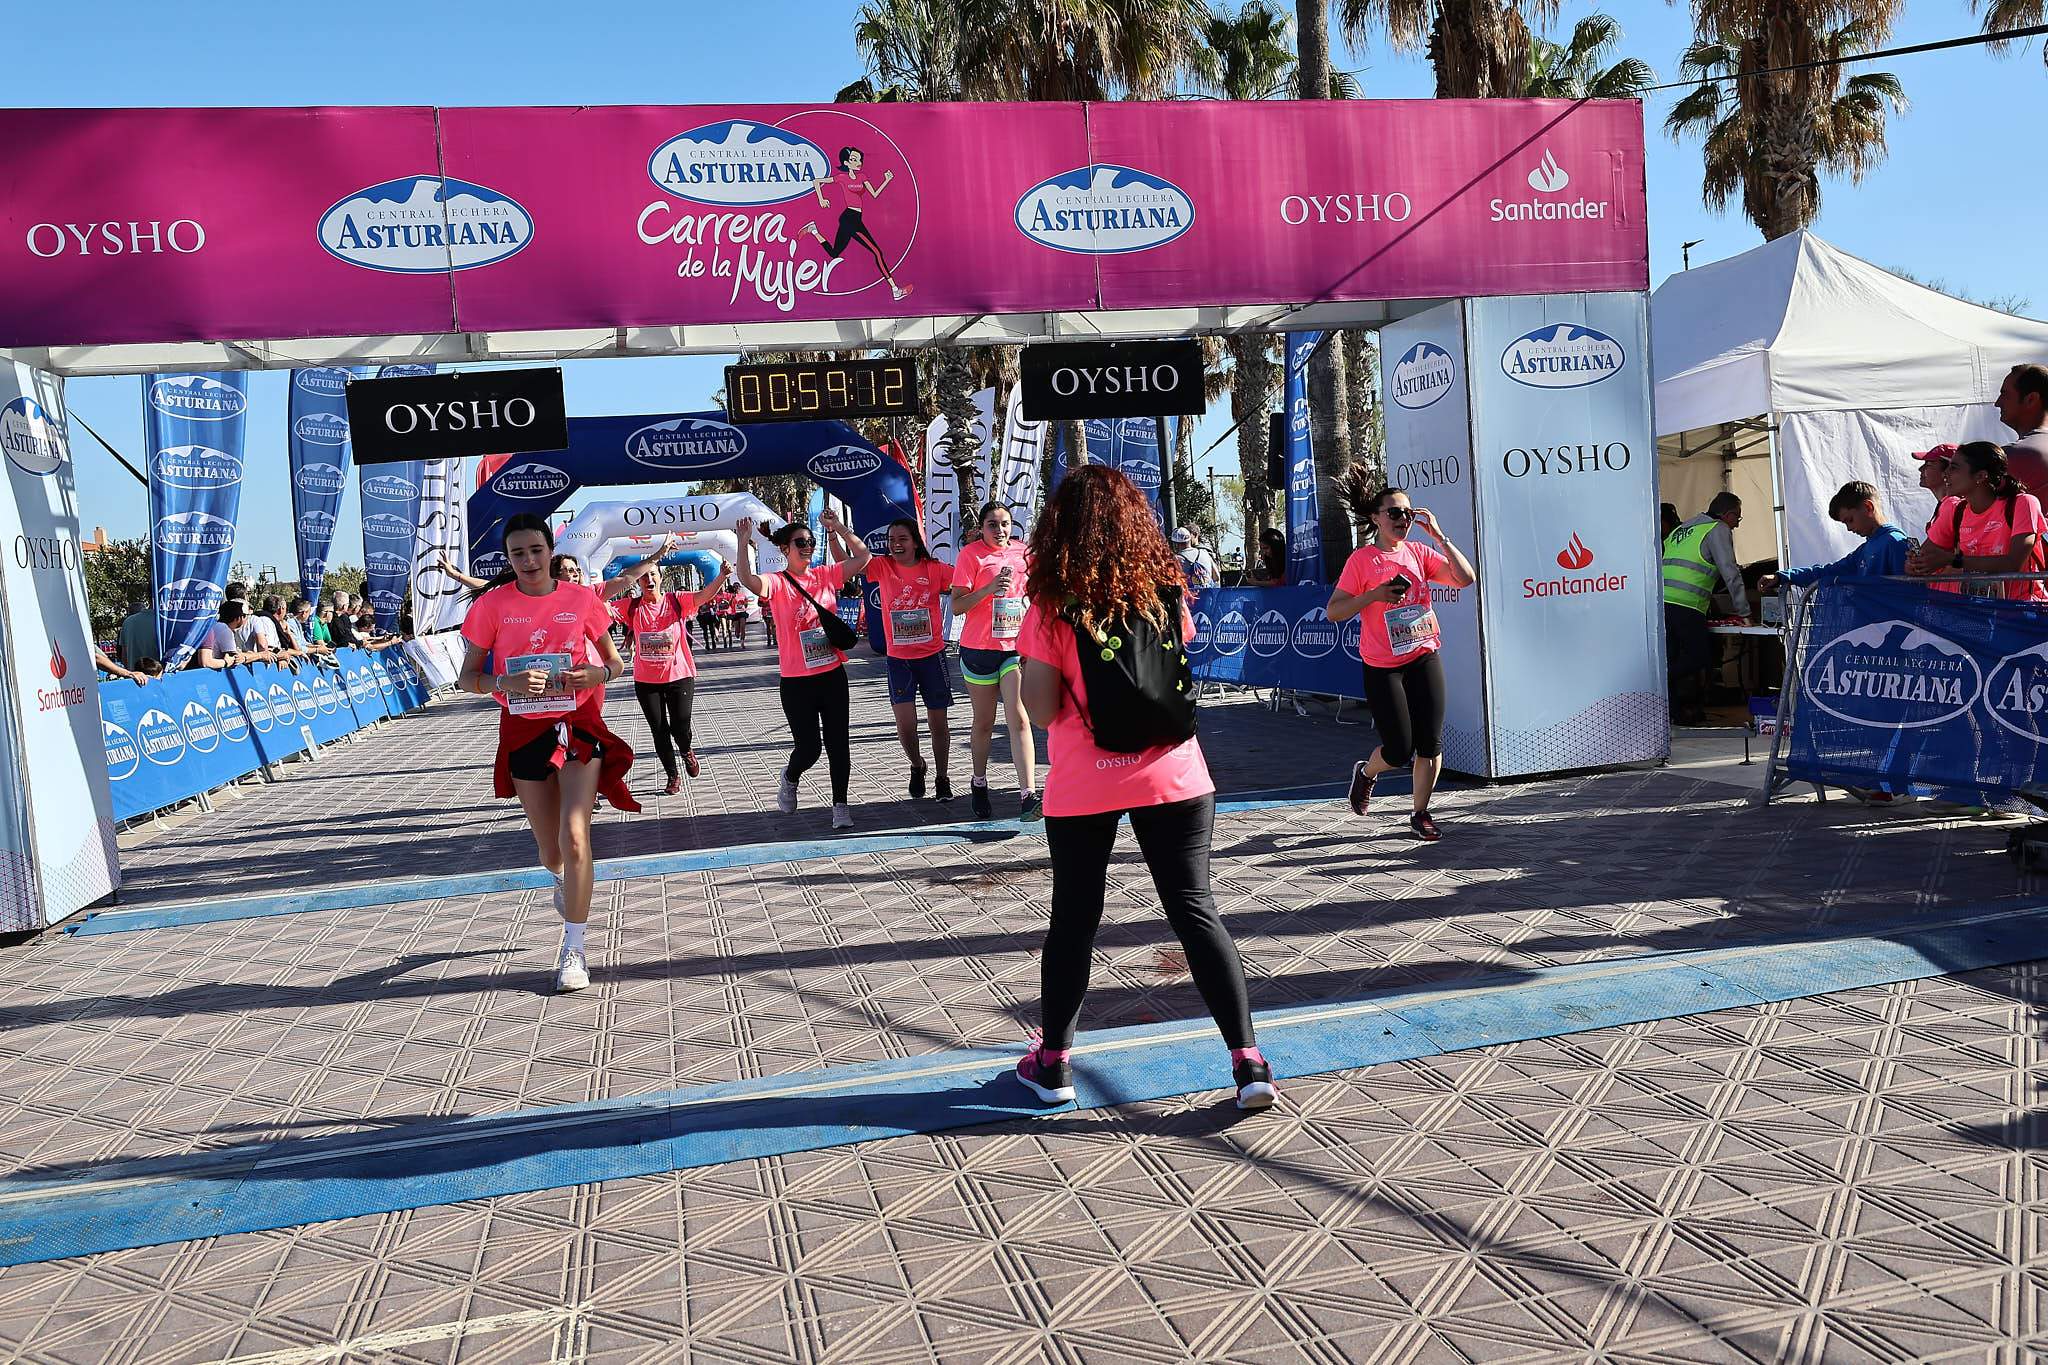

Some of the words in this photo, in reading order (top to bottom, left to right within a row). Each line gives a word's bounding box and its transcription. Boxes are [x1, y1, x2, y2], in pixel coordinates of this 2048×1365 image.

[689, 150, 747, 159] CENTRAL
[753, 149, 810, 158] LECHERA
[663, 151, 816, 184] ASTURIANA
[1056, 195, 1113, 205] CENTRAL
[1117, 194, 1176, 203] LECHERA
[1279, 192, 1412, 225] OYSHO
[1489, 197, 1608, 222] Santander
[367, 208, 434, 220] CENTRAL
[637, 200, 789, 245] Carrera
[1030, 199, 1182, 232] ASTURIANA
[26, 218, 206, 258] OYSHO
[336, 213, 519, 250] ASTURIANA
[677, 248, 706, 278] de
[712, 246, 732, 277] la
[729, 240, 845, 312] Mujer
[1528, 346, 1568, 354] CENTRAL
[1571, 344, 1611, 352] LECHERA
[1510, 349, 1617, 374] ASTURIANA
[300, 373, 345, 390] ASTURIA
[739, 368, 904, 413] 00:59:12
[1051, 364, 1179, 397] OYSHO
[1395, 371, 1451, 398] ASTURIANA
[154, 387, 240, 411] ASTURIANA
[384, 397, 536, 434] OYSHO
[635, 436, 739, 458] ASTURIANA
[157, 458, 238, 480] ASTURIANA
[814, 459, 877, 473] ASTURIANA
[1503, 442, 1631, 478] OYSHO
[497, 478, 564, 491] ASTURIANA
[1397, 455, 1460, 491] OYSHO
[365, 482, 415, 497] ASTURIANA
[623, 502, 720, 527] OYSHO
[158, 527, 232, 545] ASTURIANA
[363, 520, 411, 535] ASTURIANA
[566, 531, 597, 540] OYSHO
[14, 534, 76, 571] OYSHO
[368, 563, 407, 573] STURIANA
[1429, 585, 1461, 603] ander
[1522, 572, 1628, 600] Santander
[503, 616, 532, 625] OYSHO
[1215, 622, 1246, 644] ASTURIANA
[1252, 627, 1285, 646] ASTURIANA
[1294, 627, 1335, 646] ASTURIANA
[1845, 654, 1899, 667] CENTRAL
[1904, 658, 1963, 672] LECHERA
[1813, 655, 1964, 705] ASTURIANA
[37, 685, 87, 712] Santander
[1096, 755, 1142, 770] OYSHO
